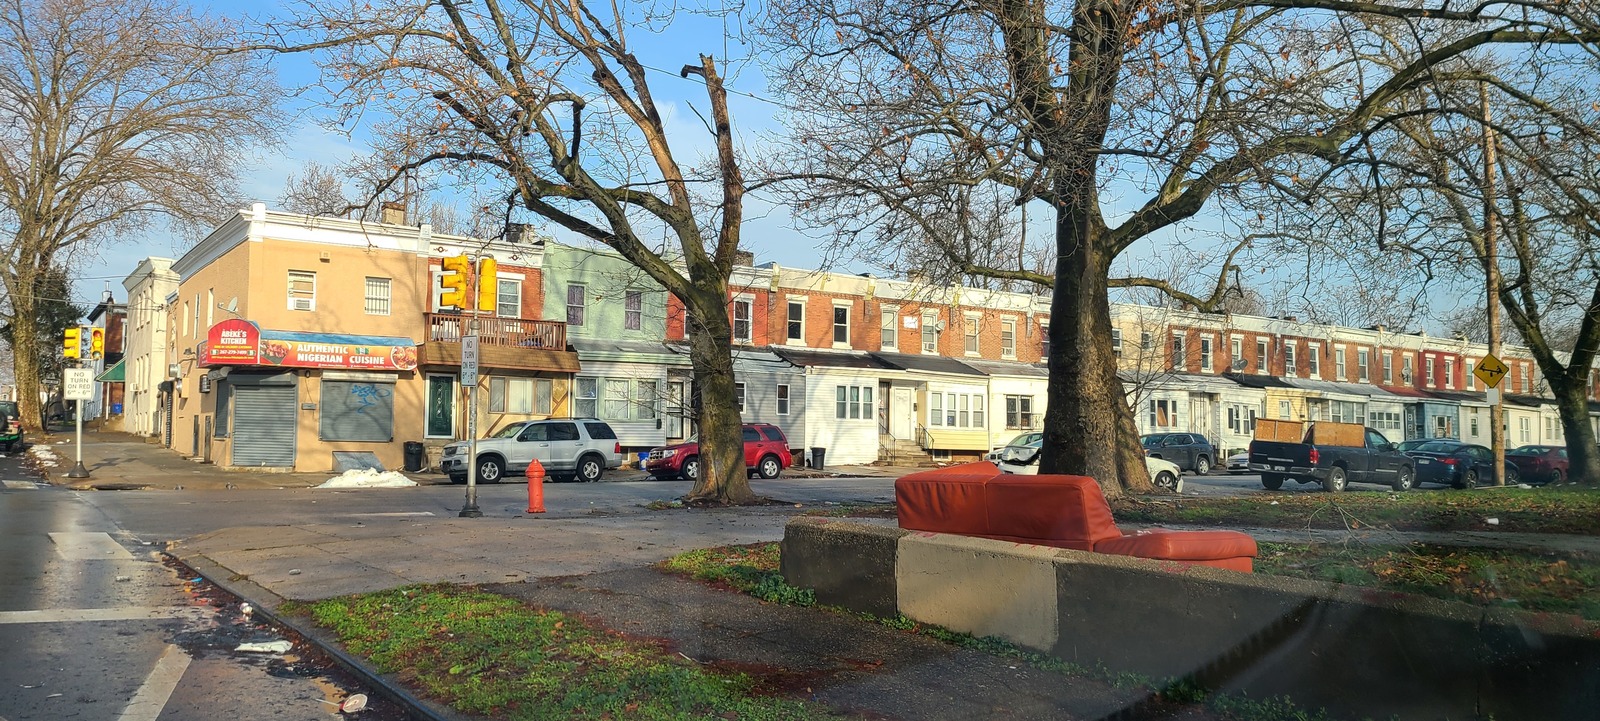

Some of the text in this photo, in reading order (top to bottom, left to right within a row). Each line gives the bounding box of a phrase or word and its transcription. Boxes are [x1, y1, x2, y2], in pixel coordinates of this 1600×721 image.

[297, 344, 348, 354] AUTHENTIC
[297, 353, 385, 364] NIGERIAN CUISINE
[464, 351, 474, 359] TURN
